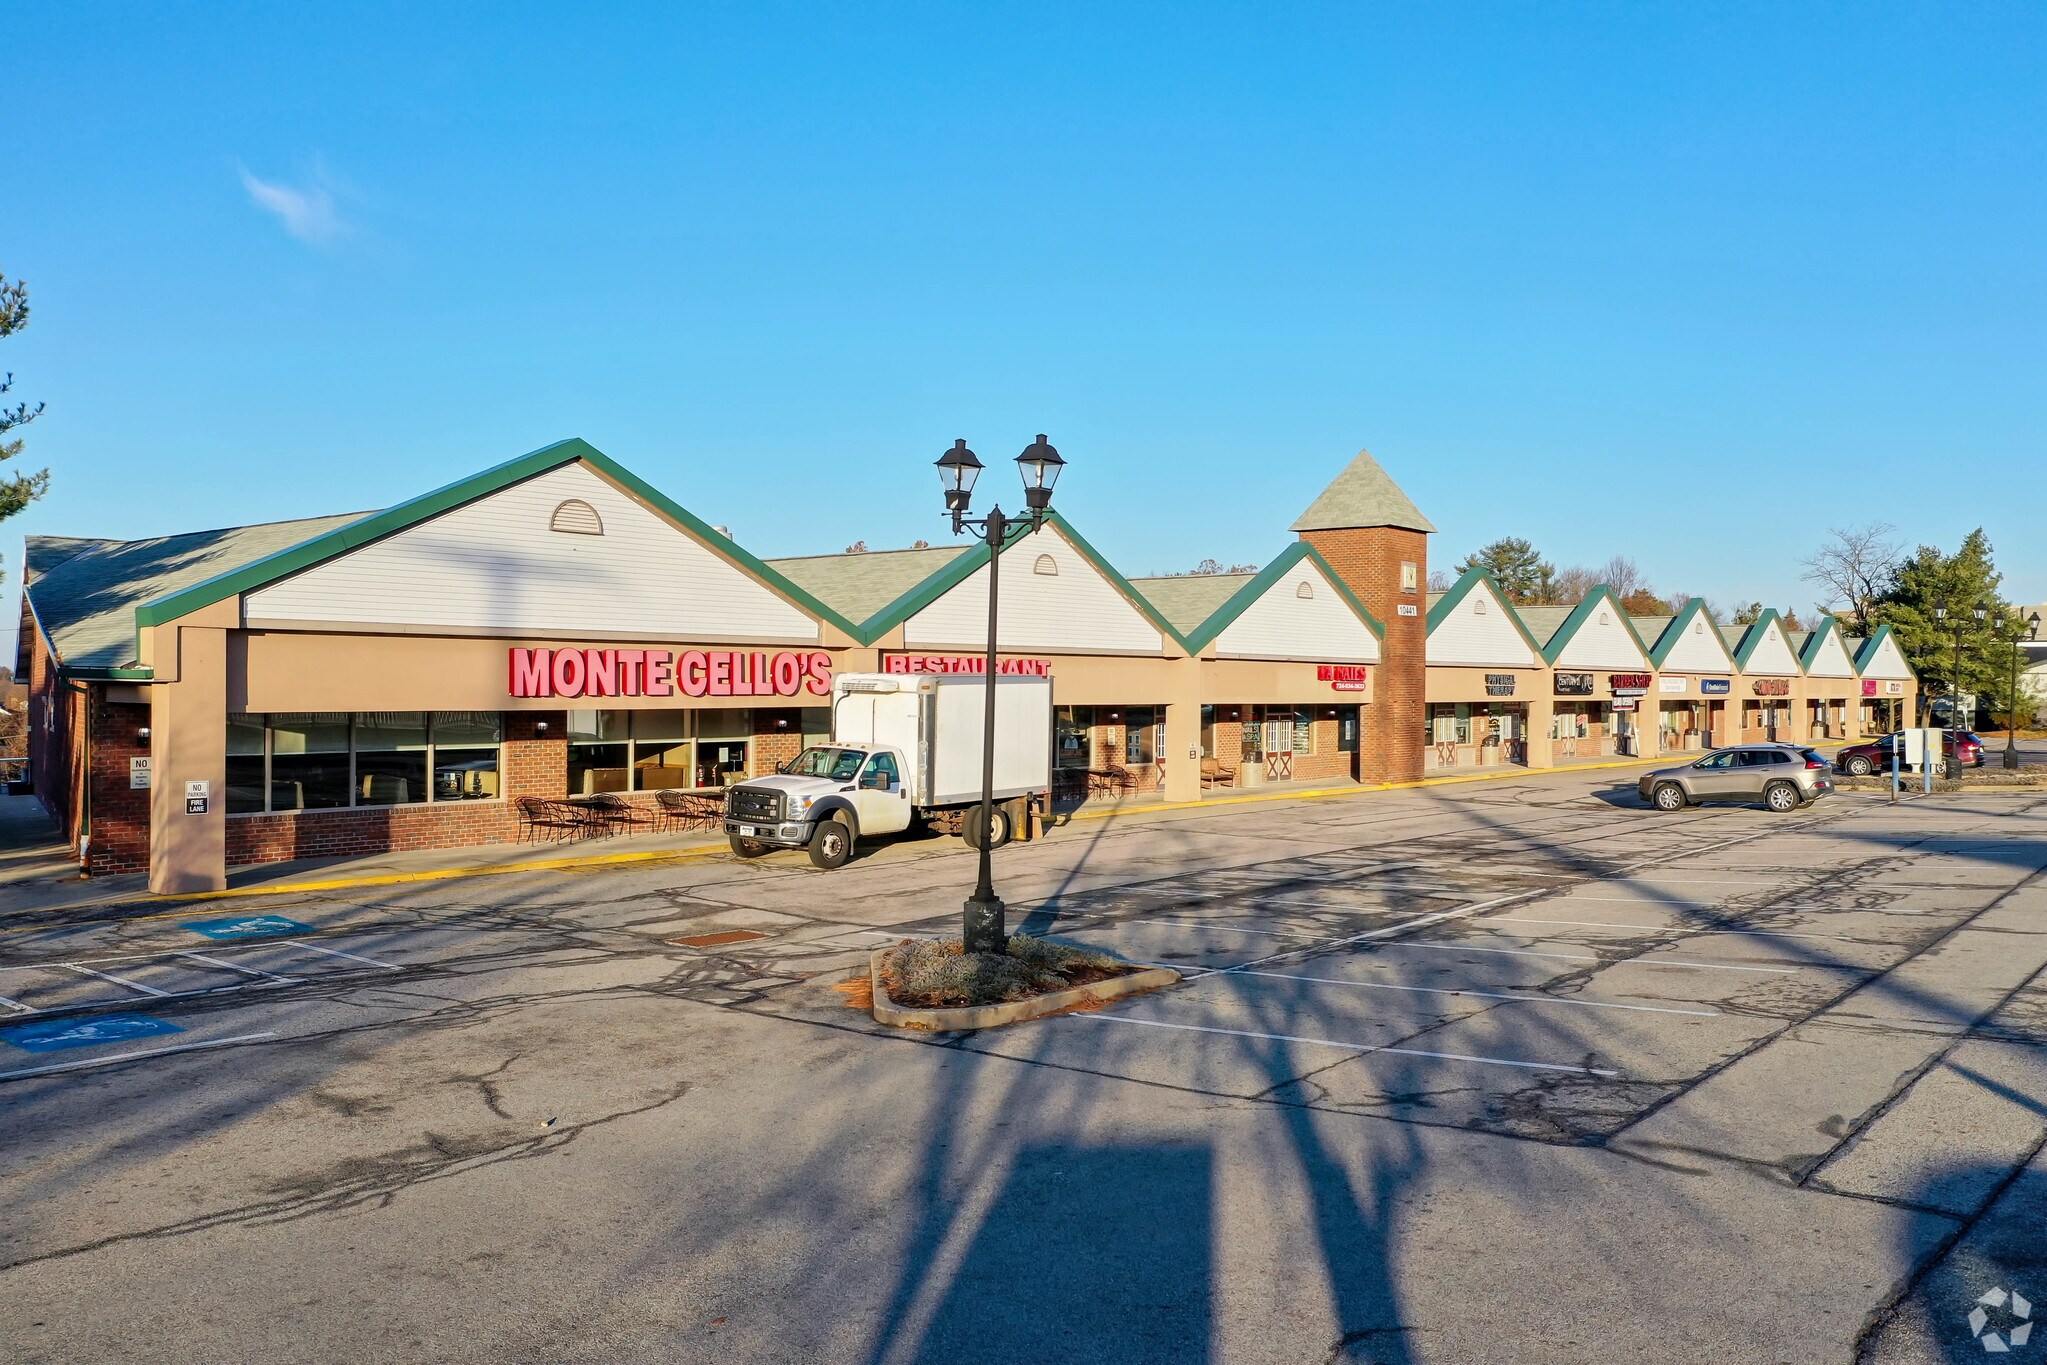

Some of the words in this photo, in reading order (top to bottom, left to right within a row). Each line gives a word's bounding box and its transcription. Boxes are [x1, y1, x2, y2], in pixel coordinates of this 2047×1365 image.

[1400, 606, 1416, 615] 10441
[509, 648, 671, 697] MONTE
[676, 650, 832, 697] CELLO'S
[1334, 667, 1367, 681] NAILS
[135, 759, 148, 768] NO
